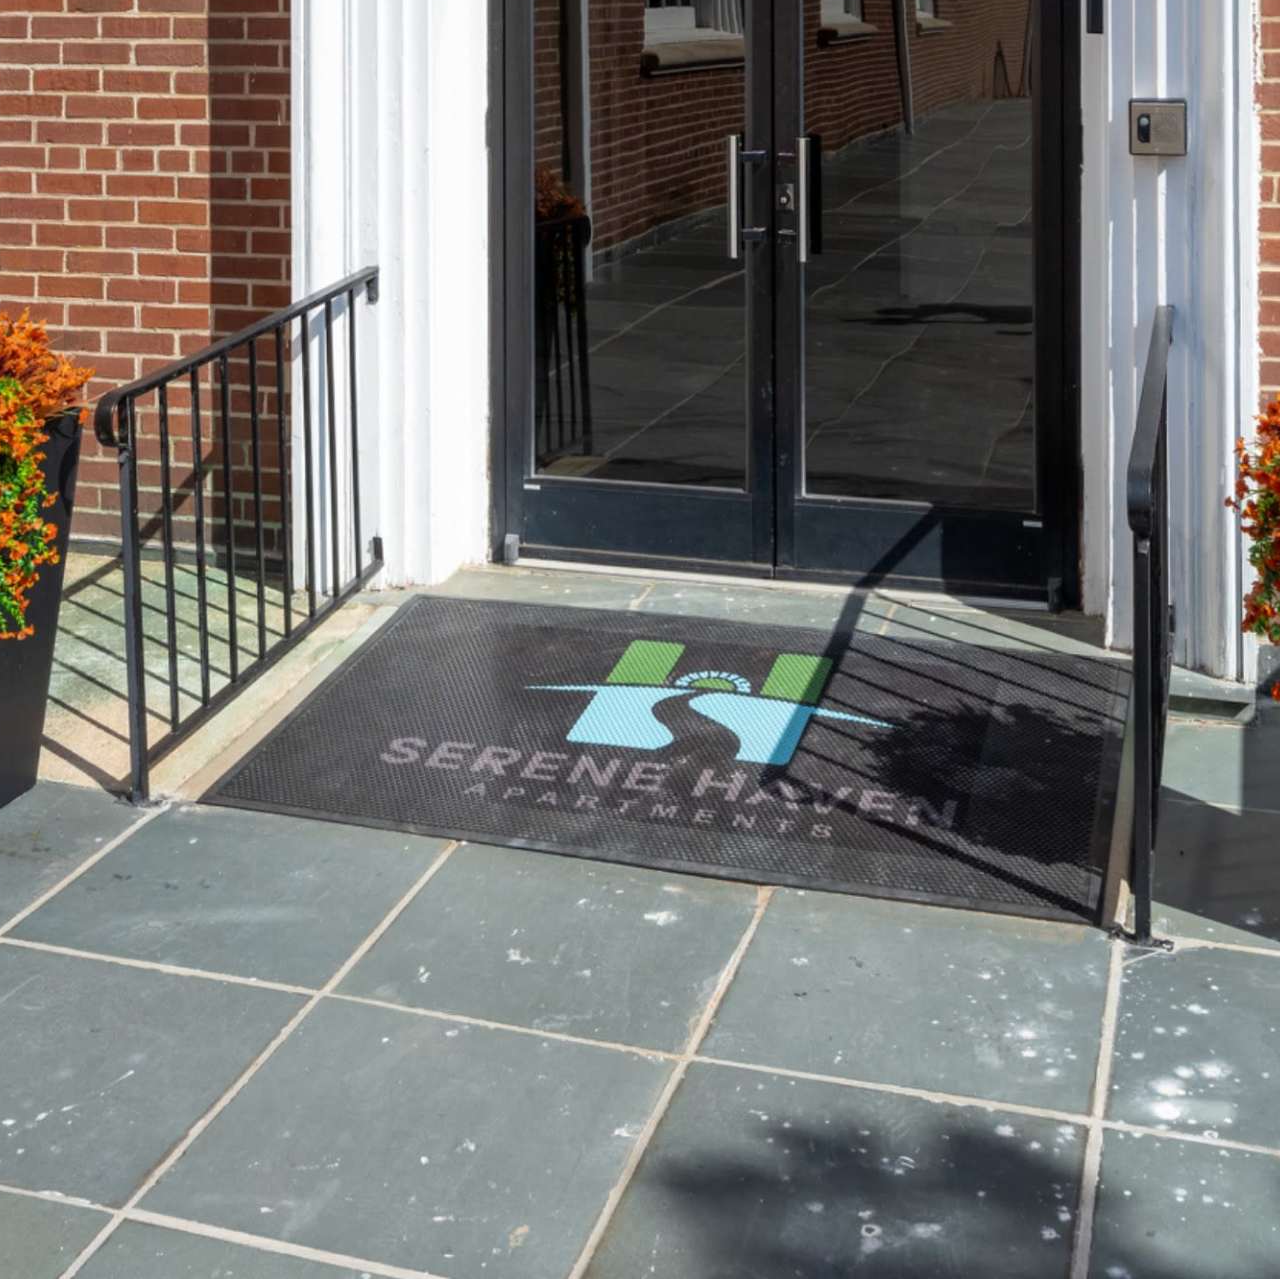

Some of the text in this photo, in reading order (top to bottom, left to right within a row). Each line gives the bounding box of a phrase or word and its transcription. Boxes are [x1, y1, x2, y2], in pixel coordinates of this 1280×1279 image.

[380, 737, 959, 830] SERENE HAVEN
[463, 781, 833, 839] APARTMENTS
